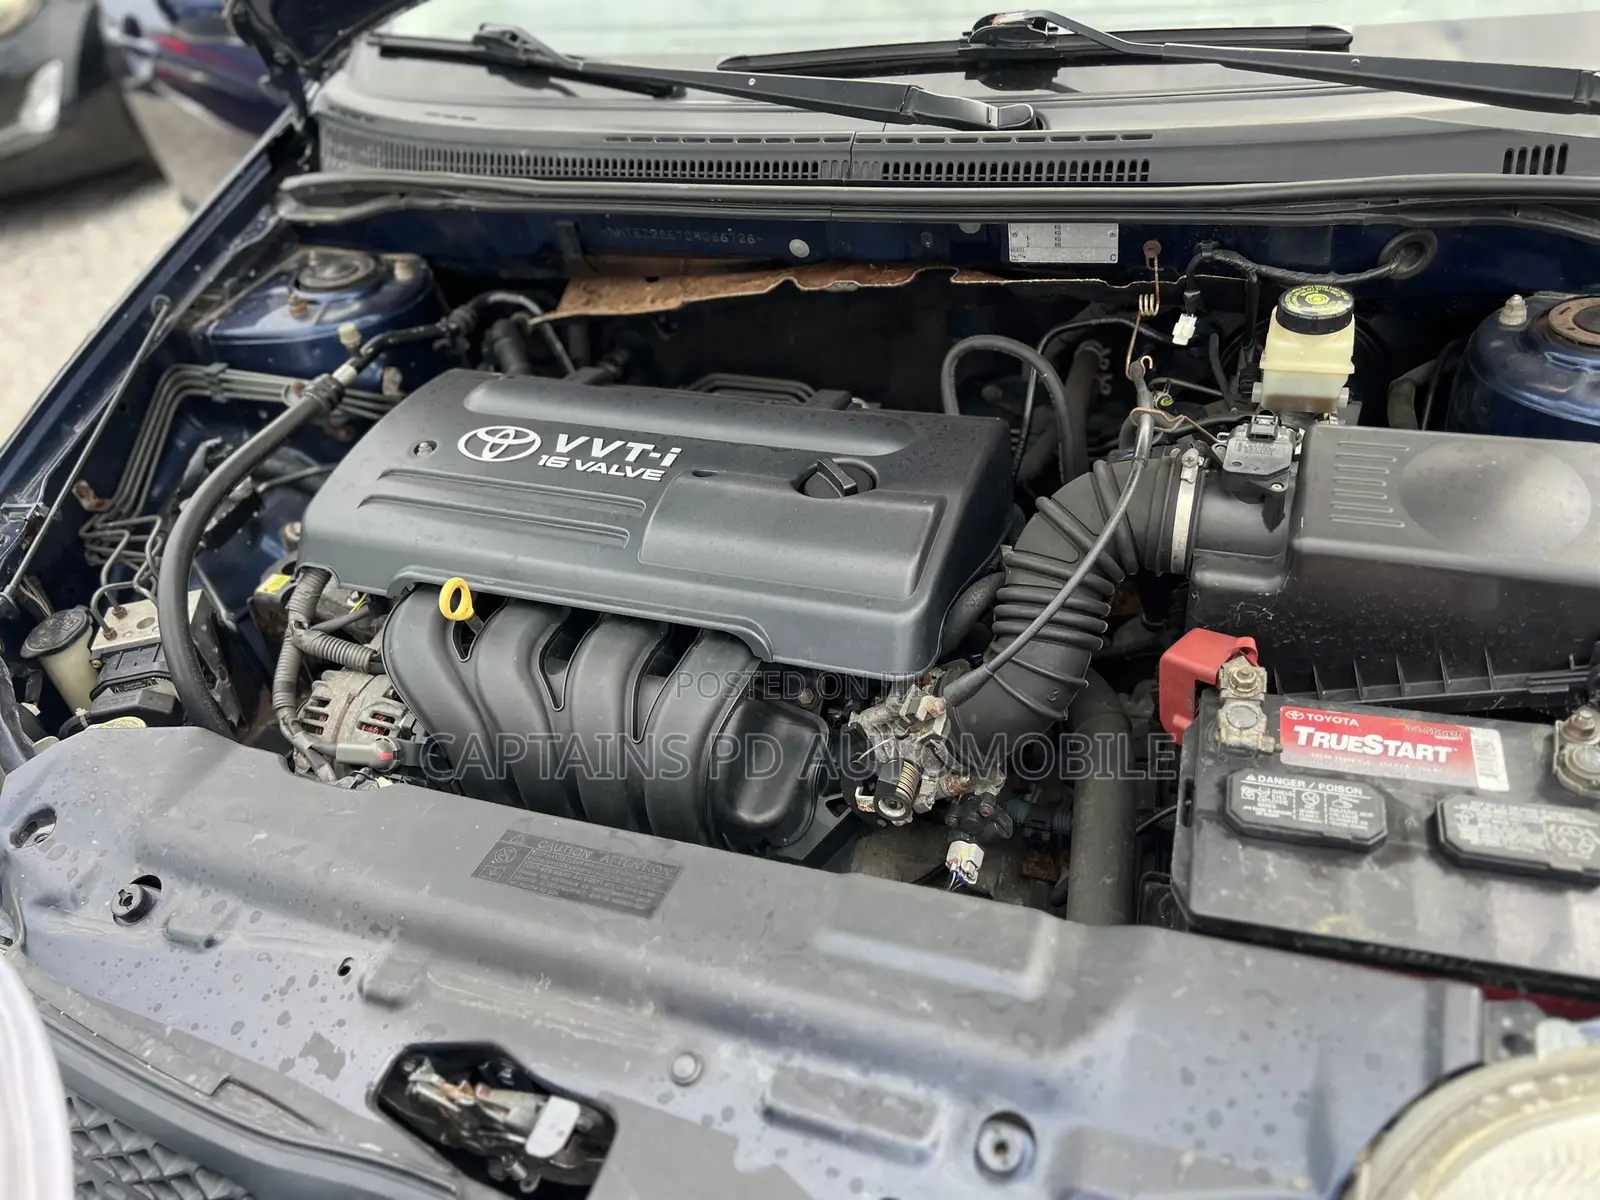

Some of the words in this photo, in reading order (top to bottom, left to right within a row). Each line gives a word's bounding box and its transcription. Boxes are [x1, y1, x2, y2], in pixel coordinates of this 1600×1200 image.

[555, 433, 683, 468] VVT-i
[538, 454, 571, 469] 16
[575, 459, 667, 482] VALVE
[1306, 713, 1359, 727] TOYOTA
[1257, 774, 1306, 789] DANGER
[1318, 782, 1362, 796] POISON
[537, 840, 593, 859] CAUTION
[600, 854, 674, 877] ATTENTION
